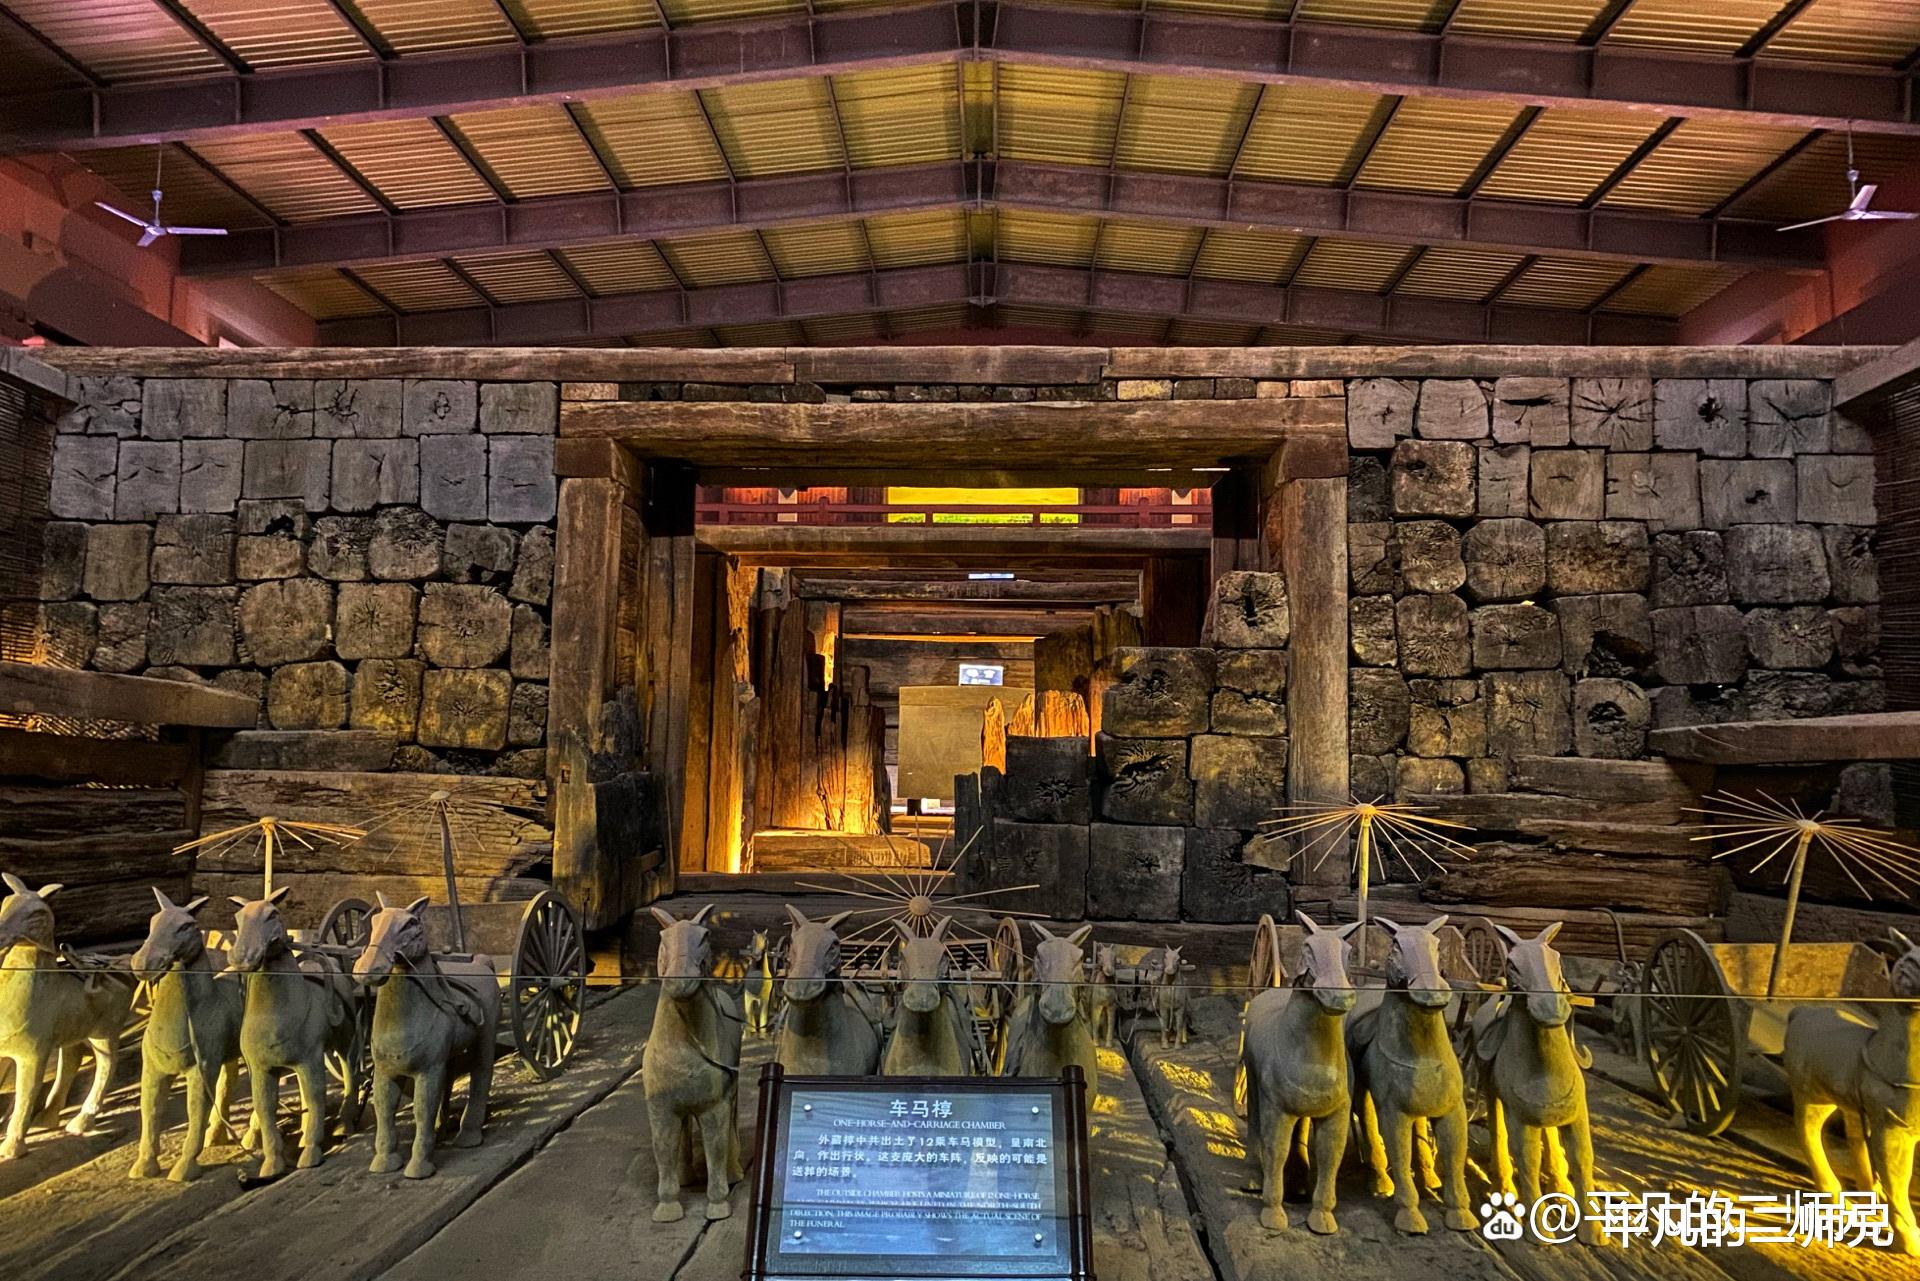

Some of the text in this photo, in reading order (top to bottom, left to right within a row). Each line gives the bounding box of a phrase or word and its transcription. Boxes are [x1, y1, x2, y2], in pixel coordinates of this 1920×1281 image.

[889, 1099, 952, 1118] 车马椁
[961, 1121, 1006, 1130] CHAMBER
[816, 1189, 831, 1197] THE
[790, 1219, 806, 1227] THE
